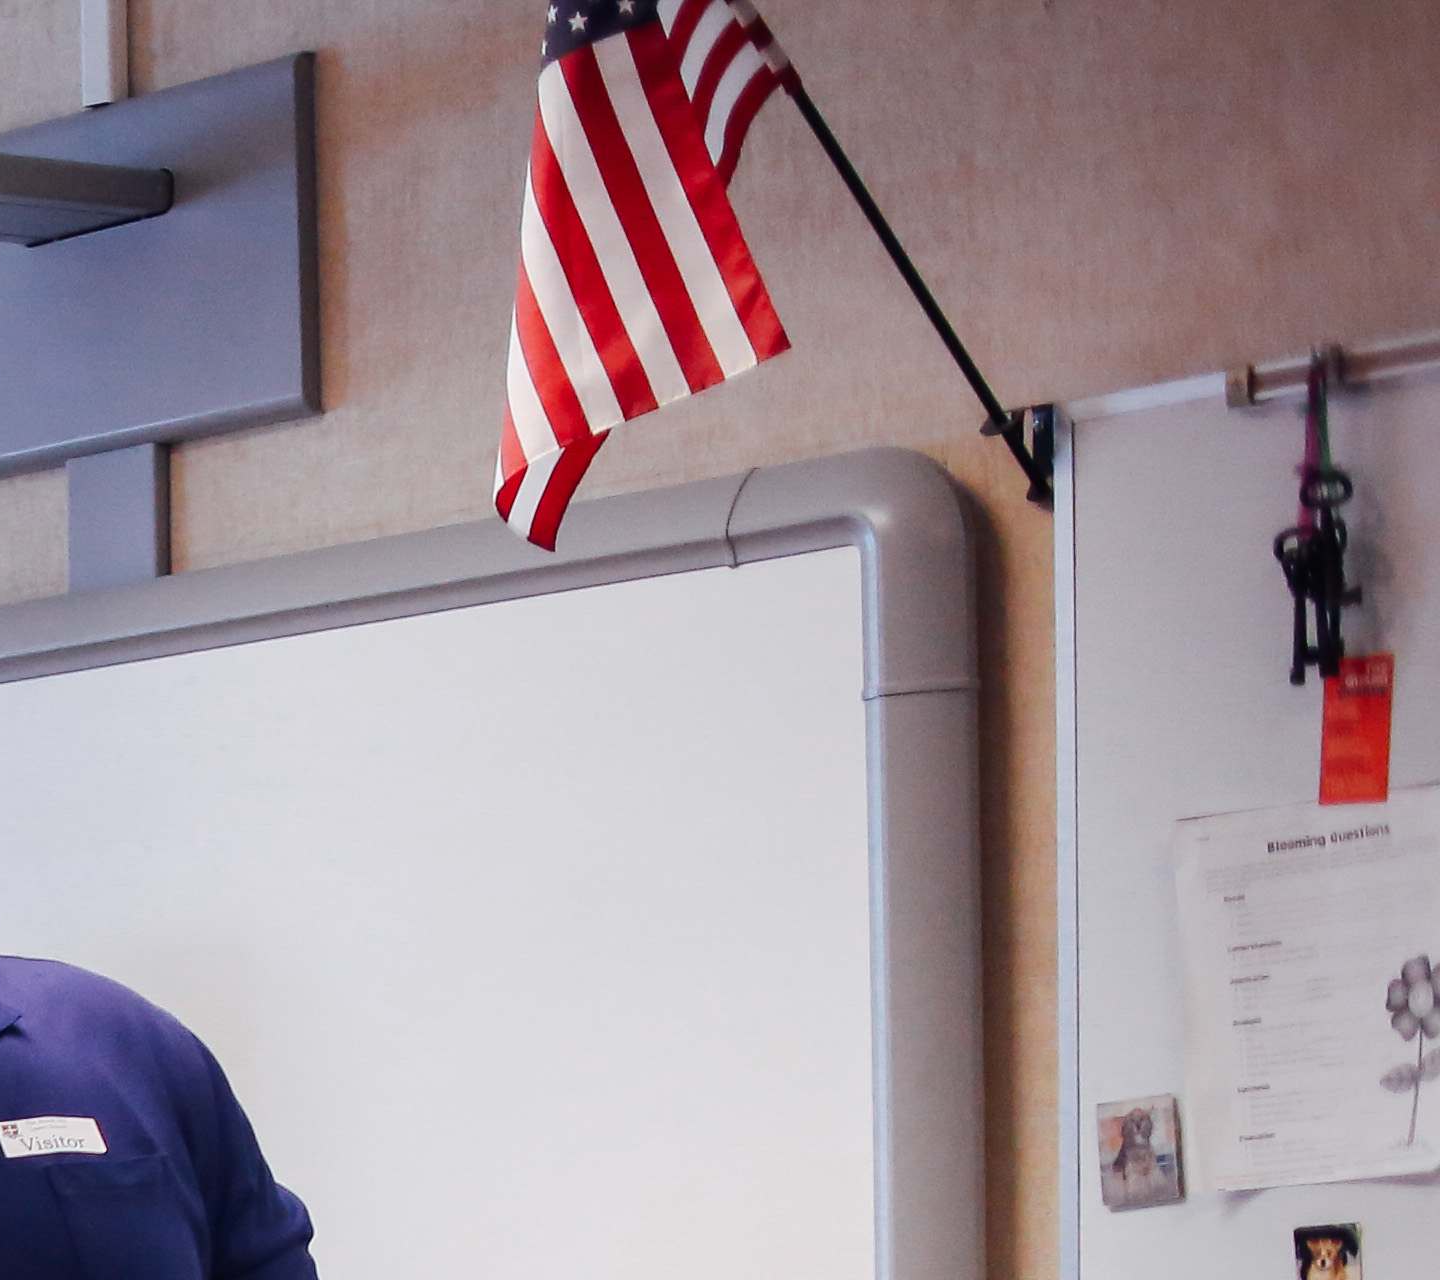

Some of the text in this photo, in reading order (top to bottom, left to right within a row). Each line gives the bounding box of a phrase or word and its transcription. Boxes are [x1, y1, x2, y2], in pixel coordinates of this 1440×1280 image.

[1266, 823, 1391, 854] Blooming Questions
[20, 1134, 85, 1151] Visitor
